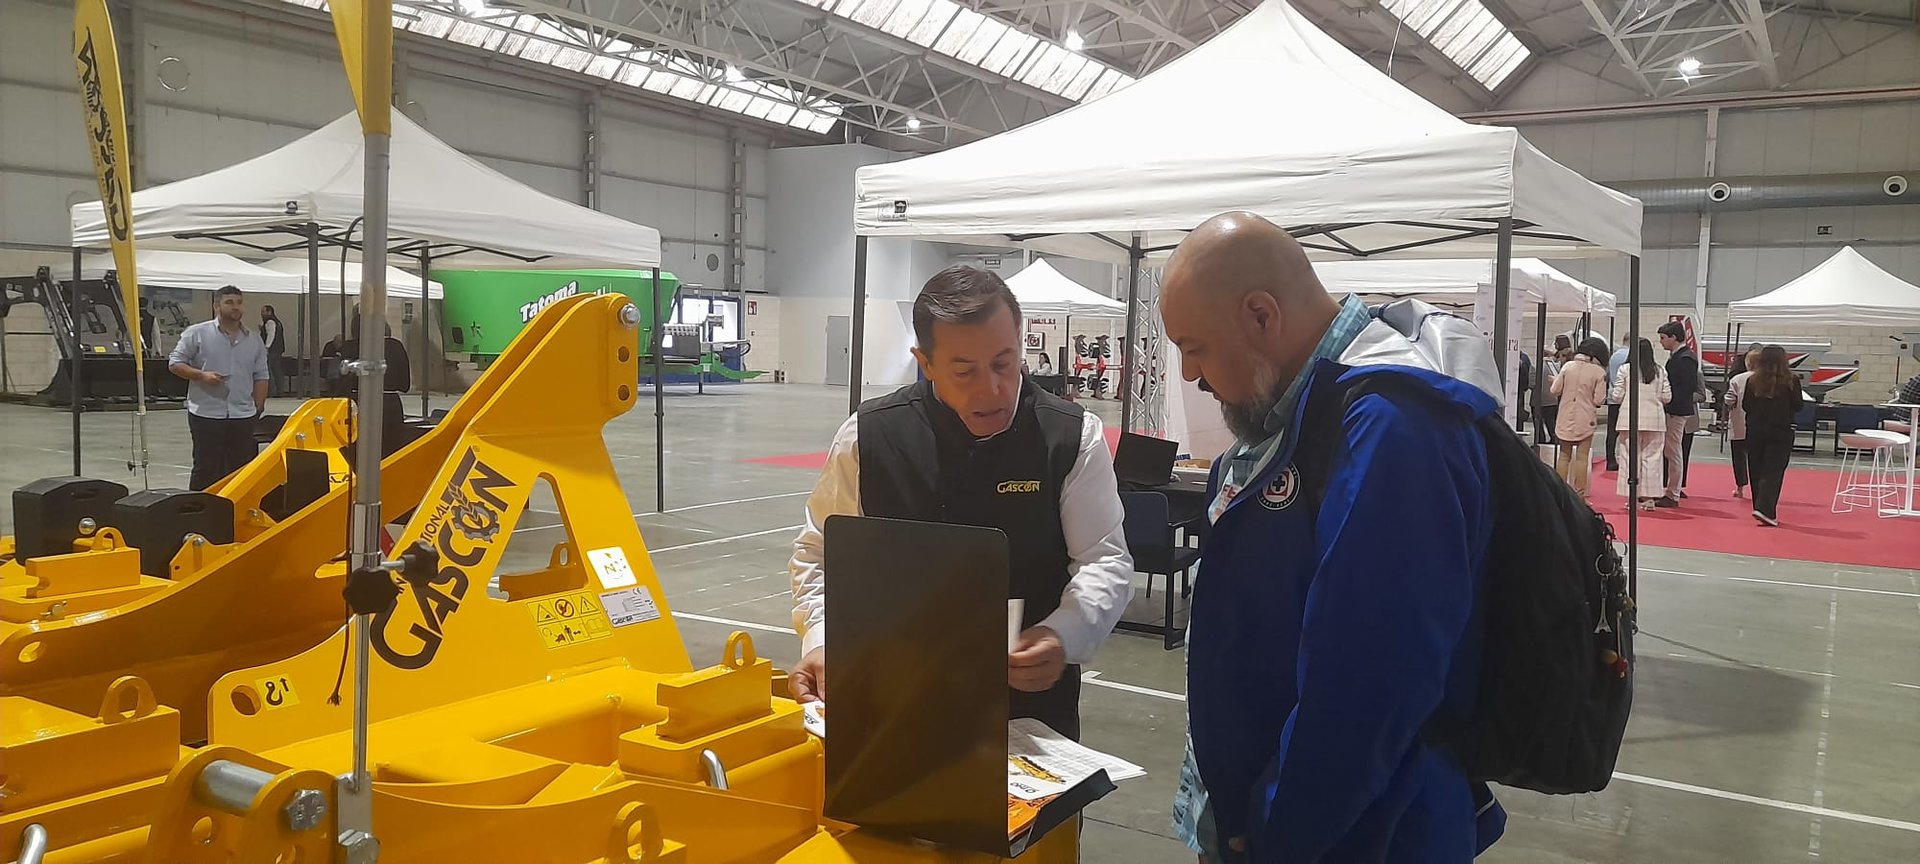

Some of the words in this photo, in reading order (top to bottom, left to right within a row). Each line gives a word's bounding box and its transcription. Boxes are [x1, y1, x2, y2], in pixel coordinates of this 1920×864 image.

[520, 280, 579, 323] Tatoma
[996, 480, 1041, 494] GASCON
[370, 445, 518, 670] GASCON
